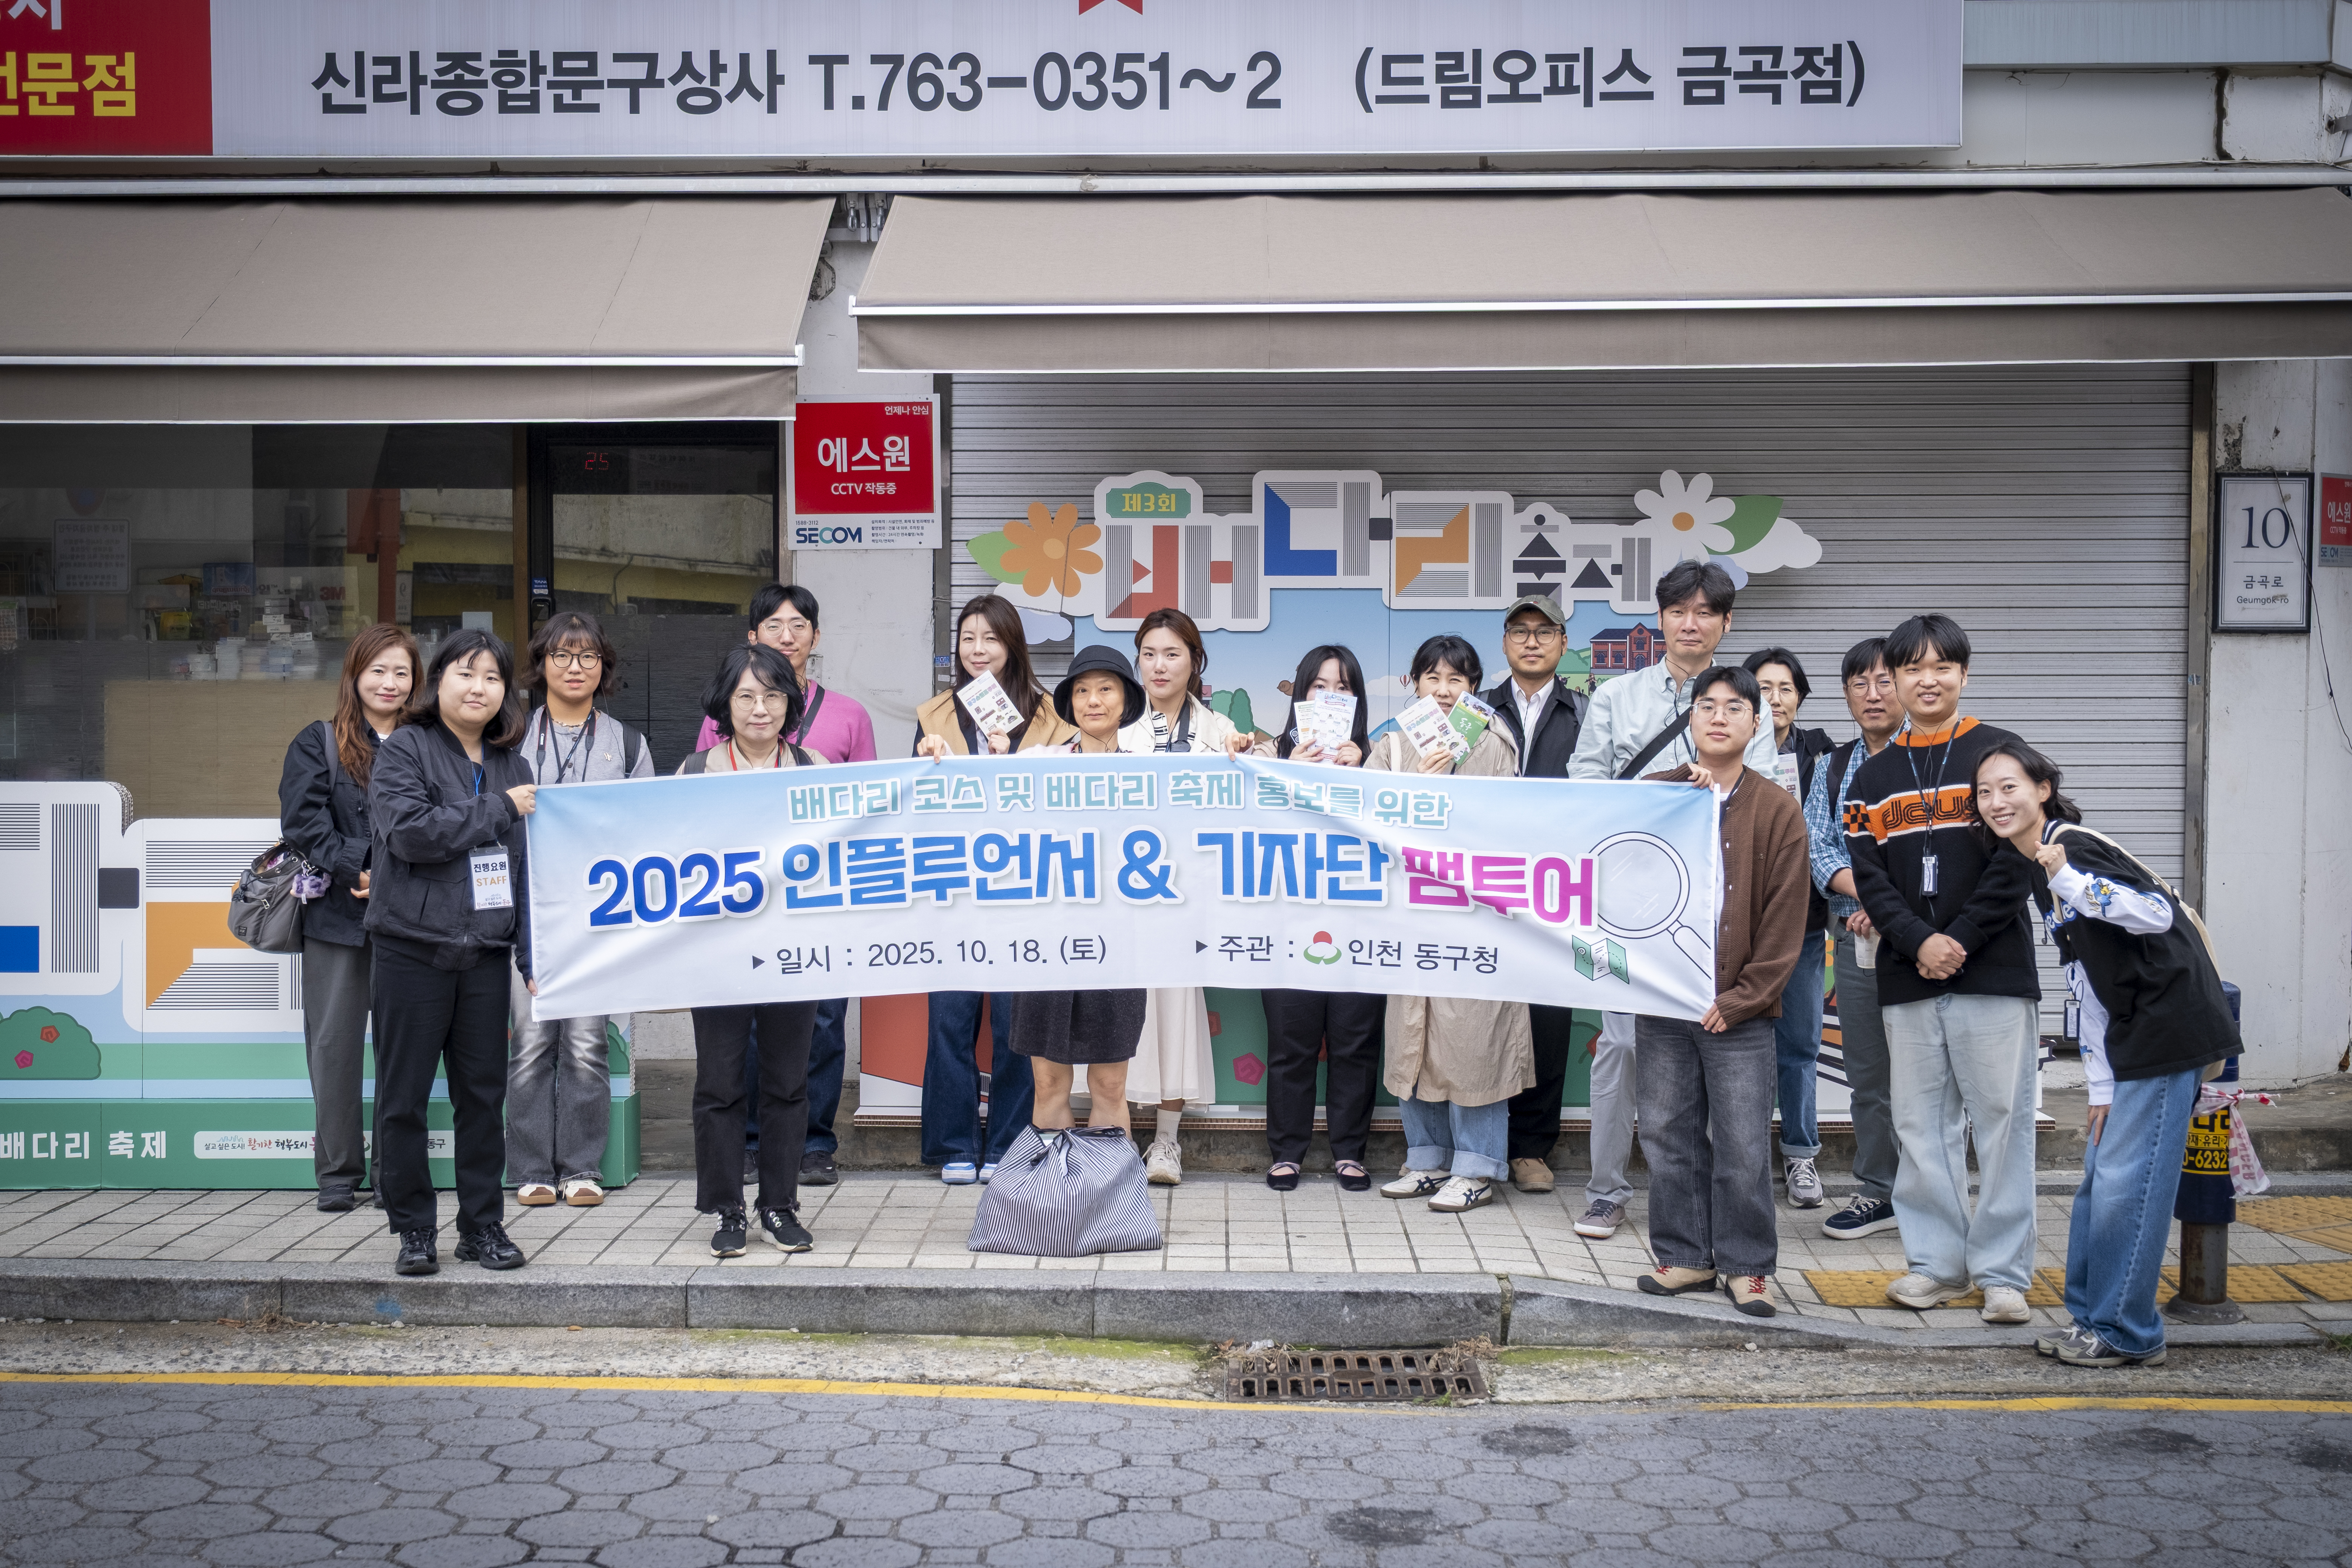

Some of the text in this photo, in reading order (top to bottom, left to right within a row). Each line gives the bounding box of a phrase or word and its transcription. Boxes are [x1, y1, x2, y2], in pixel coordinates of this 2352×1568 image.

[311, 49, 786, 116] 신라종합문구상사
[1355, 46, 1654, 113] (드림오피스
[1677, 40, 1865, 107] 금곡점)
[884, 405, 929, 415] 언제나 안심
[585, 451, 609, 470] 25
[818, 436, 911, 473] 에스원
[831, 482, 897, 495] CCTV 작동중
[1122, 493, 1176, 513] 제3회
[2327, 501, 2351, 524] 에스원
[796, 527, 862, 544] SECOM
[2241, 507, 2290, 549] 10
[2243, 575, 2284, 590] 금곡로
[320, 586, 346, 600] 3M
[2236, 595, 2289, 606] Geumgok-ro
[790, 773, 1449, 826] 배다리 코스 및 배다리 축제 홍보를 위한
[474, 861, 507, 873] 진행요원
[476, 875, 507, 887] STAFF
[588, 830, 1593, 927] 2025 인플루언서 & 기자단 팸투어
[776, 945, 830, 975] 일시
[868, 941, 942, 967] 2025.
[957, 940, 994, 965] 10.
[1008, 939, 1047, 964] 18.
[1060, 935, 1106, 965] (토)
[1218, 935, 1274, 962] 주관
[1348, 939, 1401, 968] 인천
[1414, 943, 1498, 974] 동구청
[0, 1130, 166, 1160] 배다리 축제
[247, 1138, 273, 1151] 활기찬
[275, 1139, 308, 1150] 행복도시
